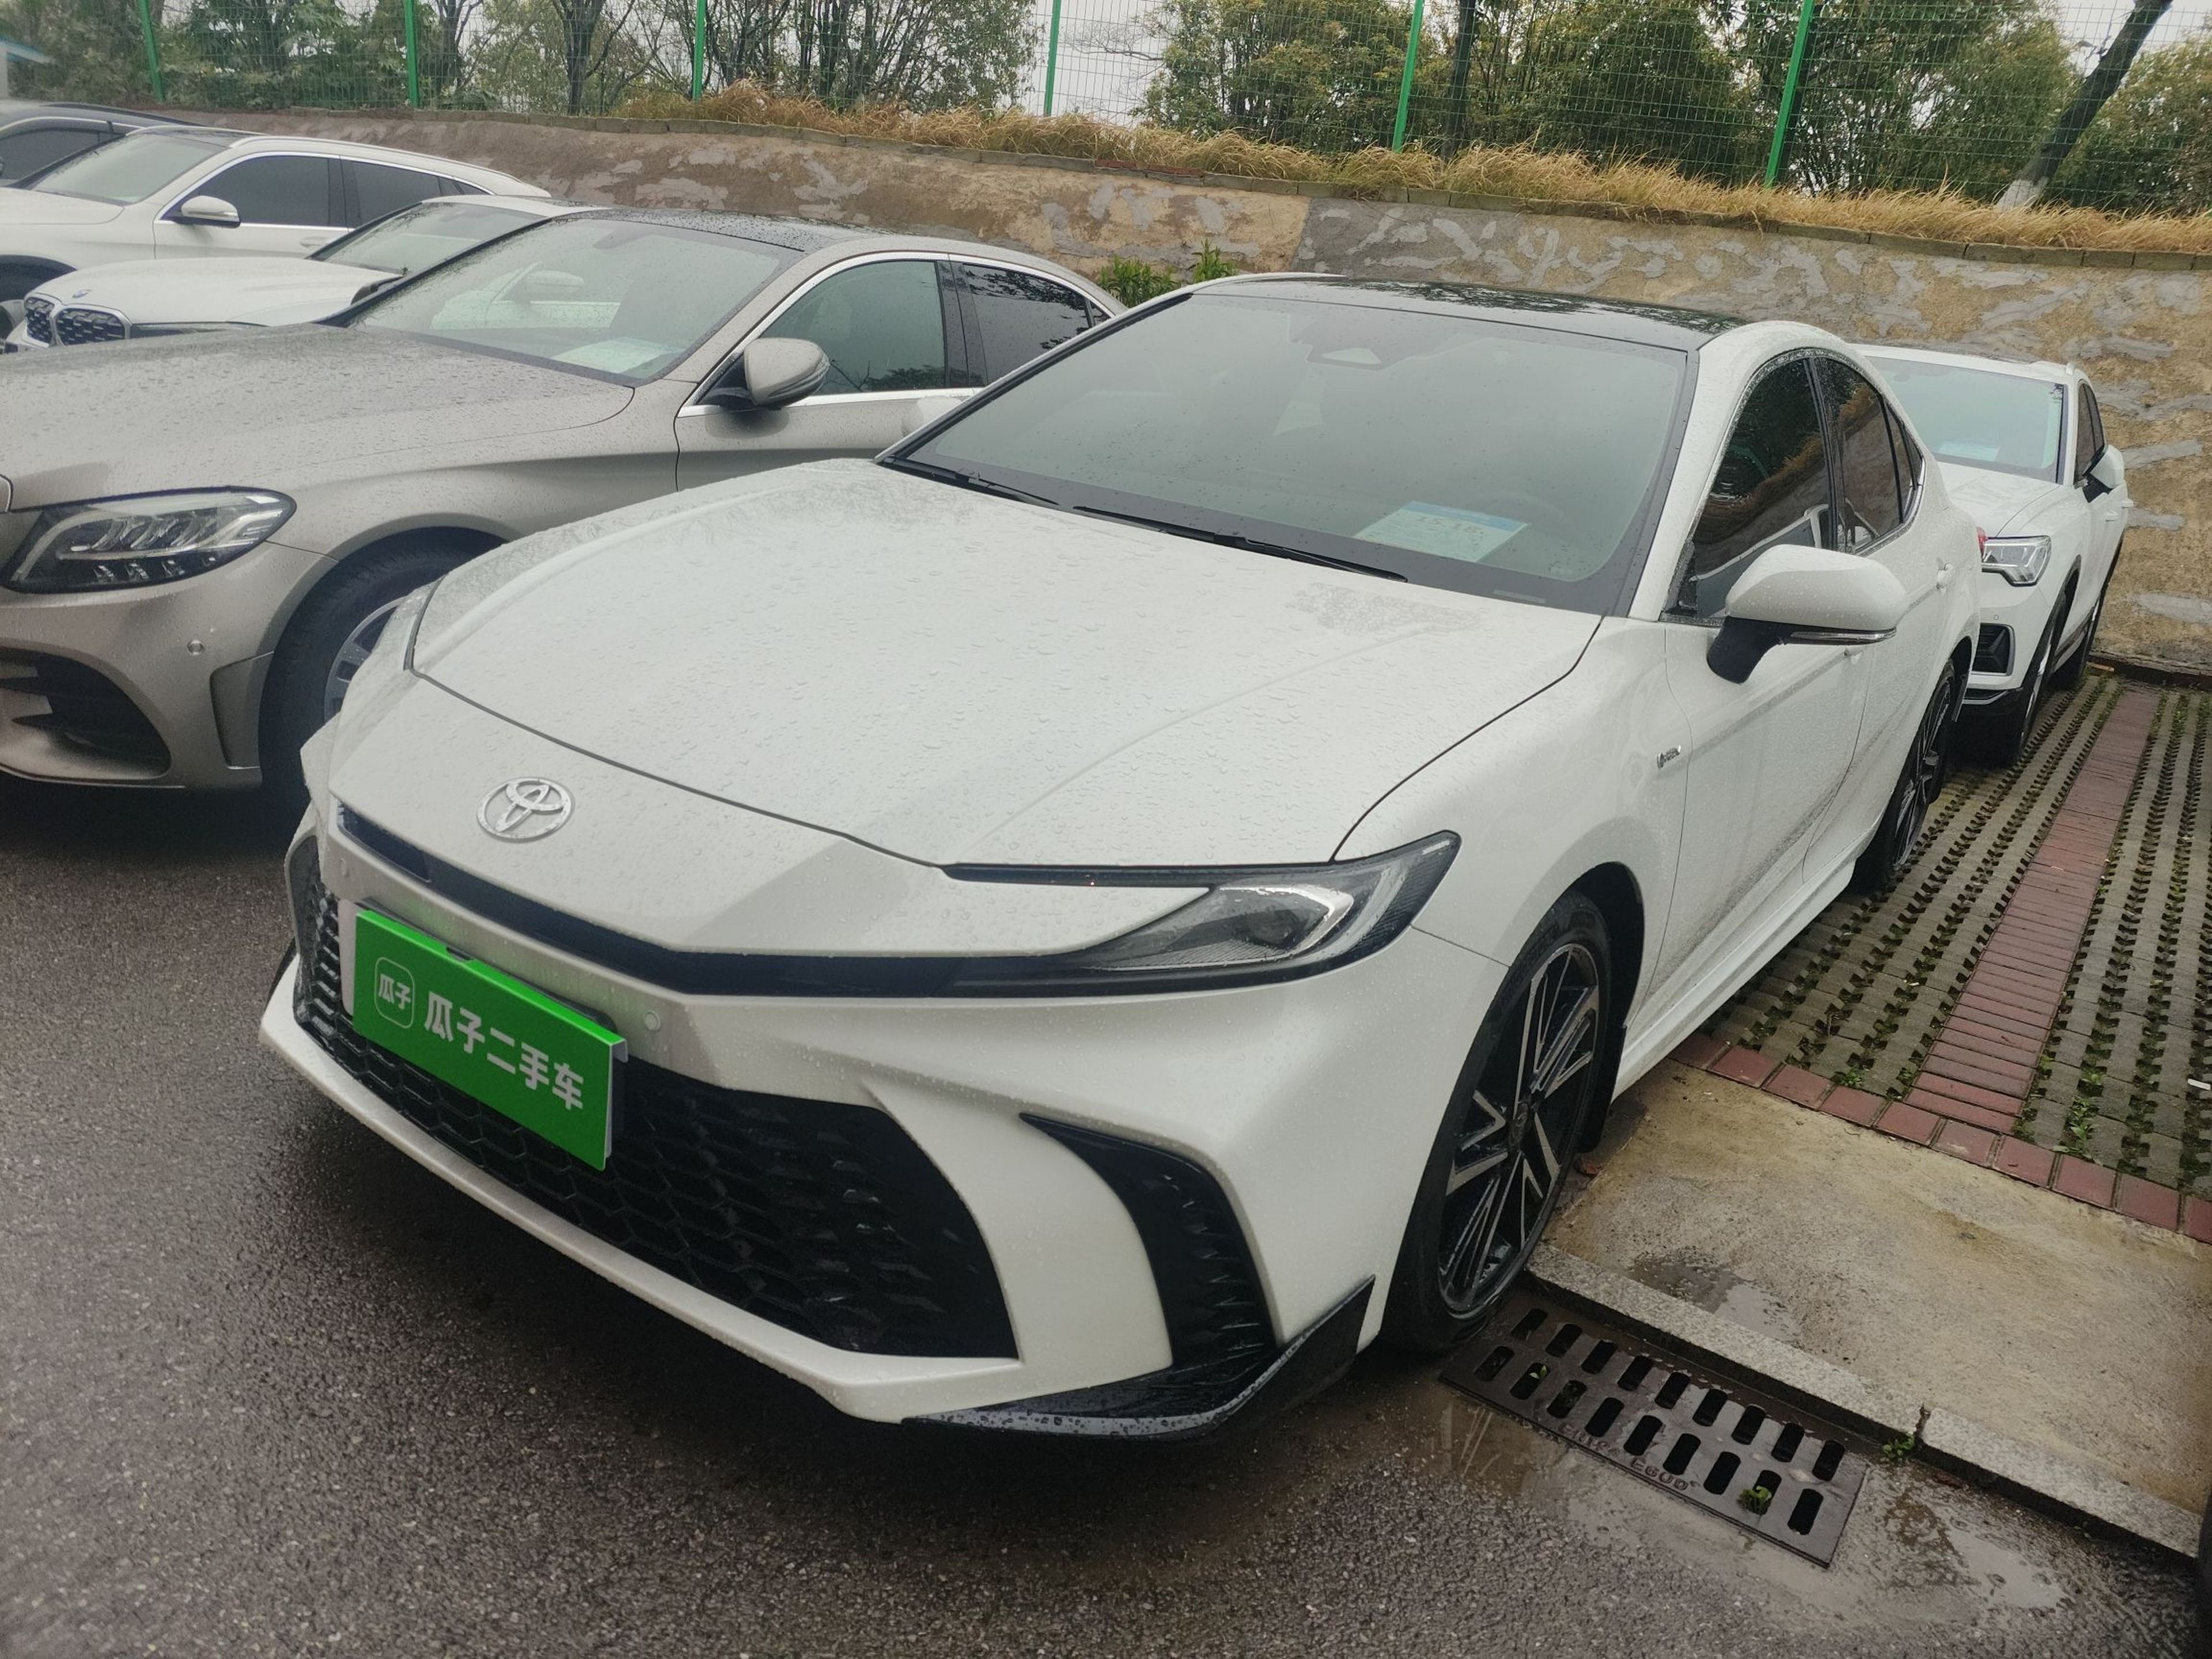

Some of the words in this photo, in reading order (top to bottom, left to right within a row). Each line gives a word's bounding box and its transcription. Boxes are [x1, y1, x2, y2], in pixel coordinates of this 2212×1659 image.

[377, 973, 412, 1010] 瓜子
[424, 991, 584, 1110] 瓜子二手车
